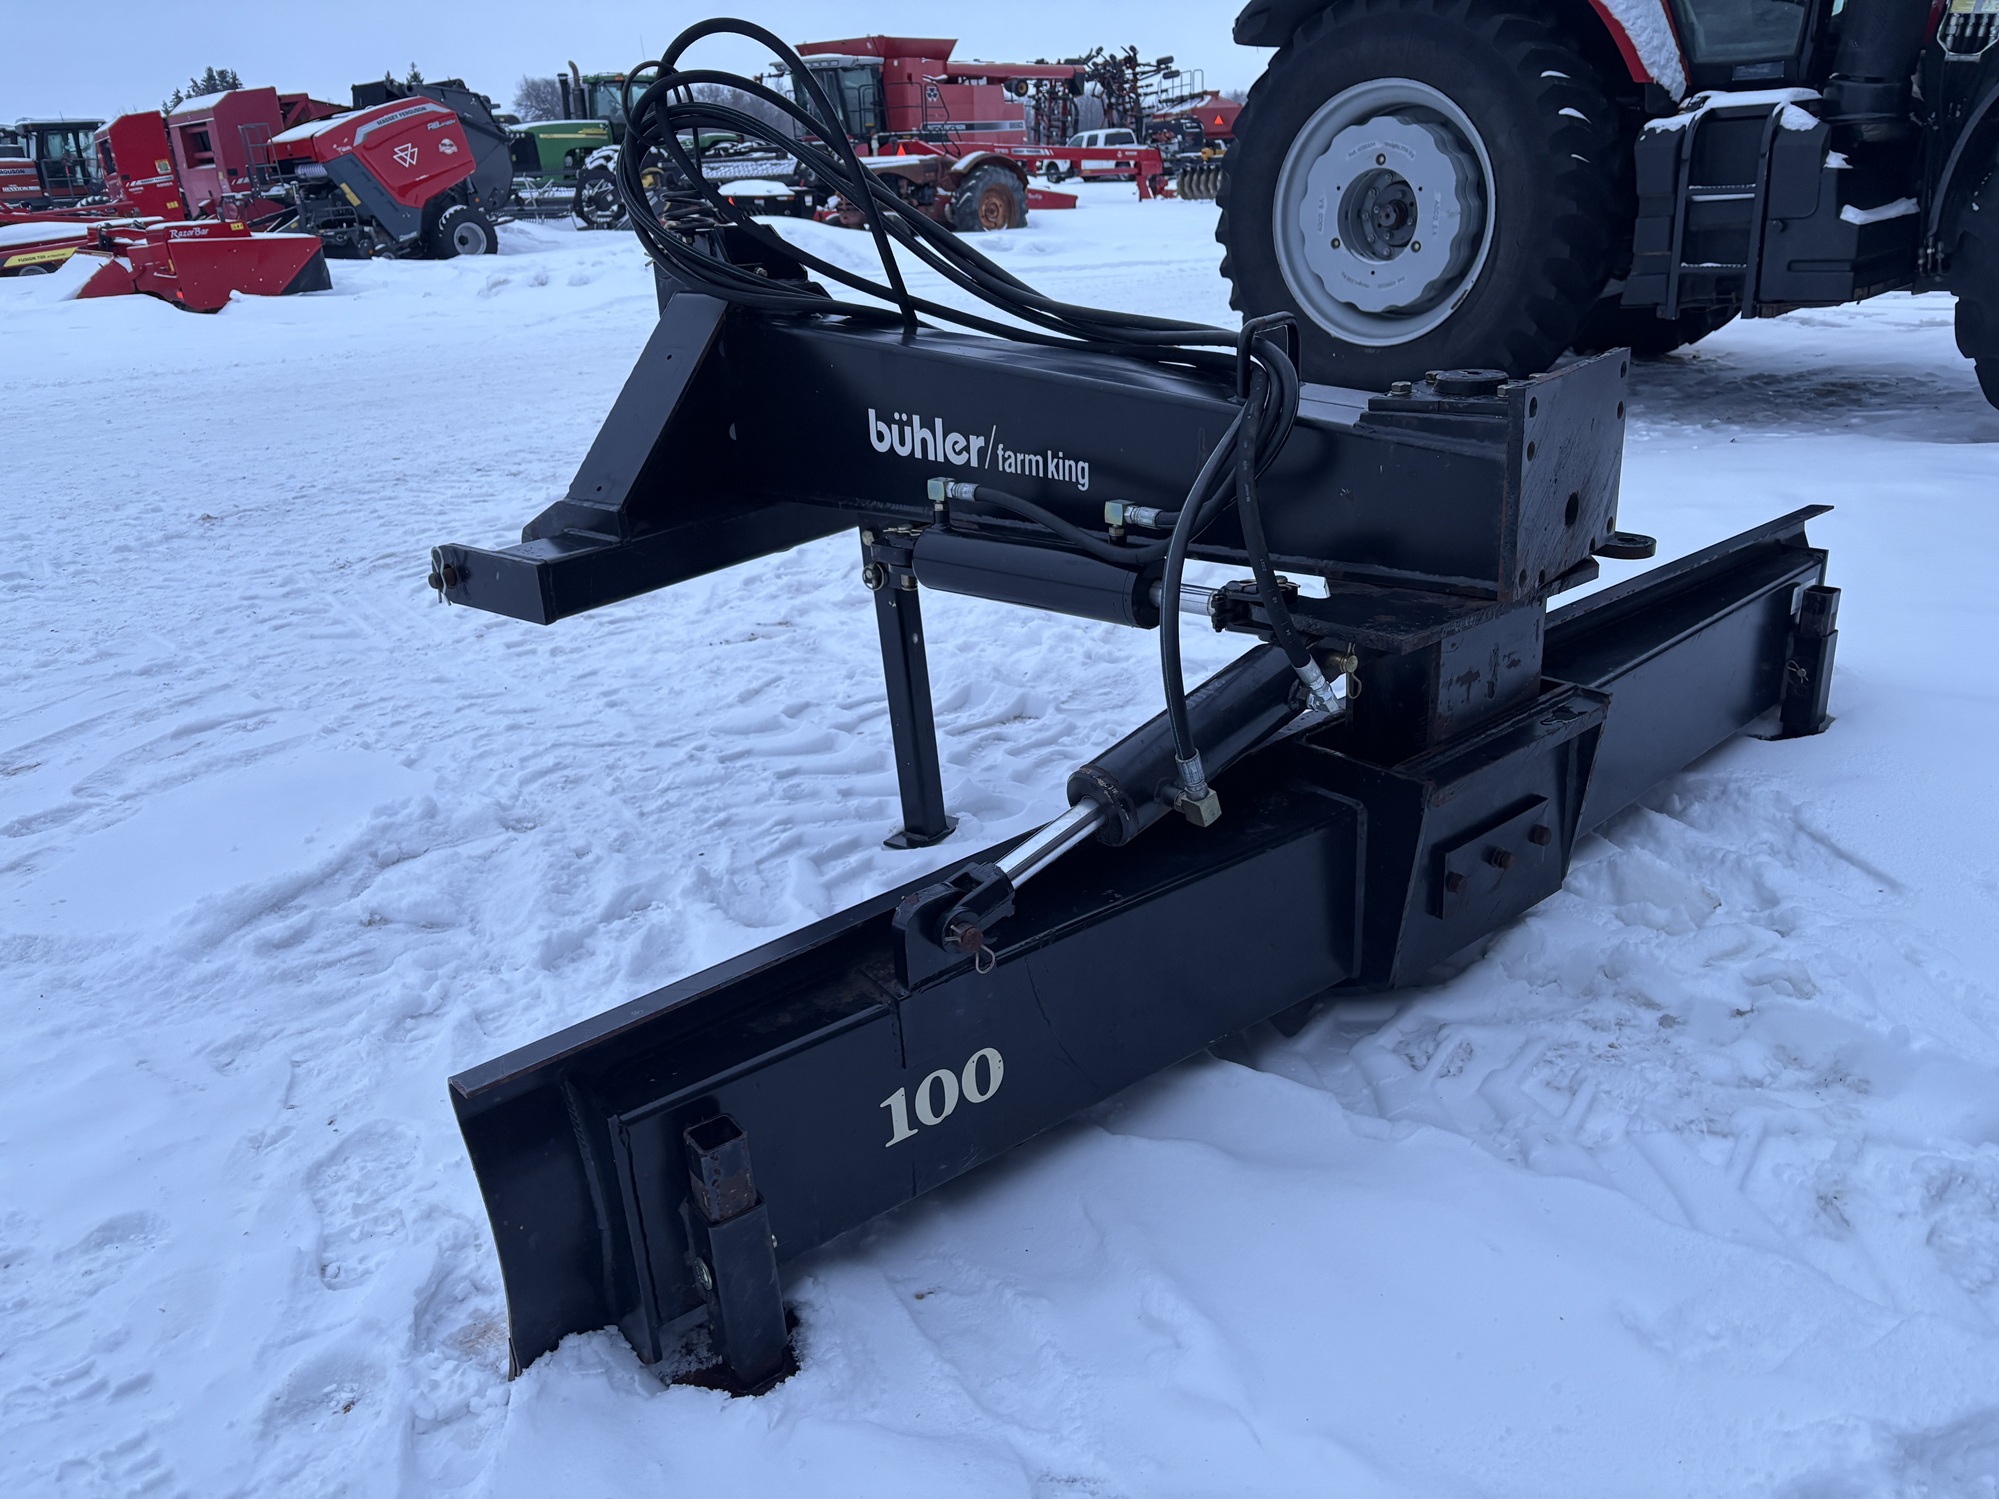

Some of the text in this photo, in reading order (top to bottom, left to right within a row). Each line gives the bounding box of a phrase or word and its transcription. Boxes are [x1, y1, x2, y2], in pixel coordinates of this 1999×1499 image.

[997, 443, 1044, 478] farm
[1047, 450, 1090, 492] king
[879, 1047, 1005, 1148] 100
